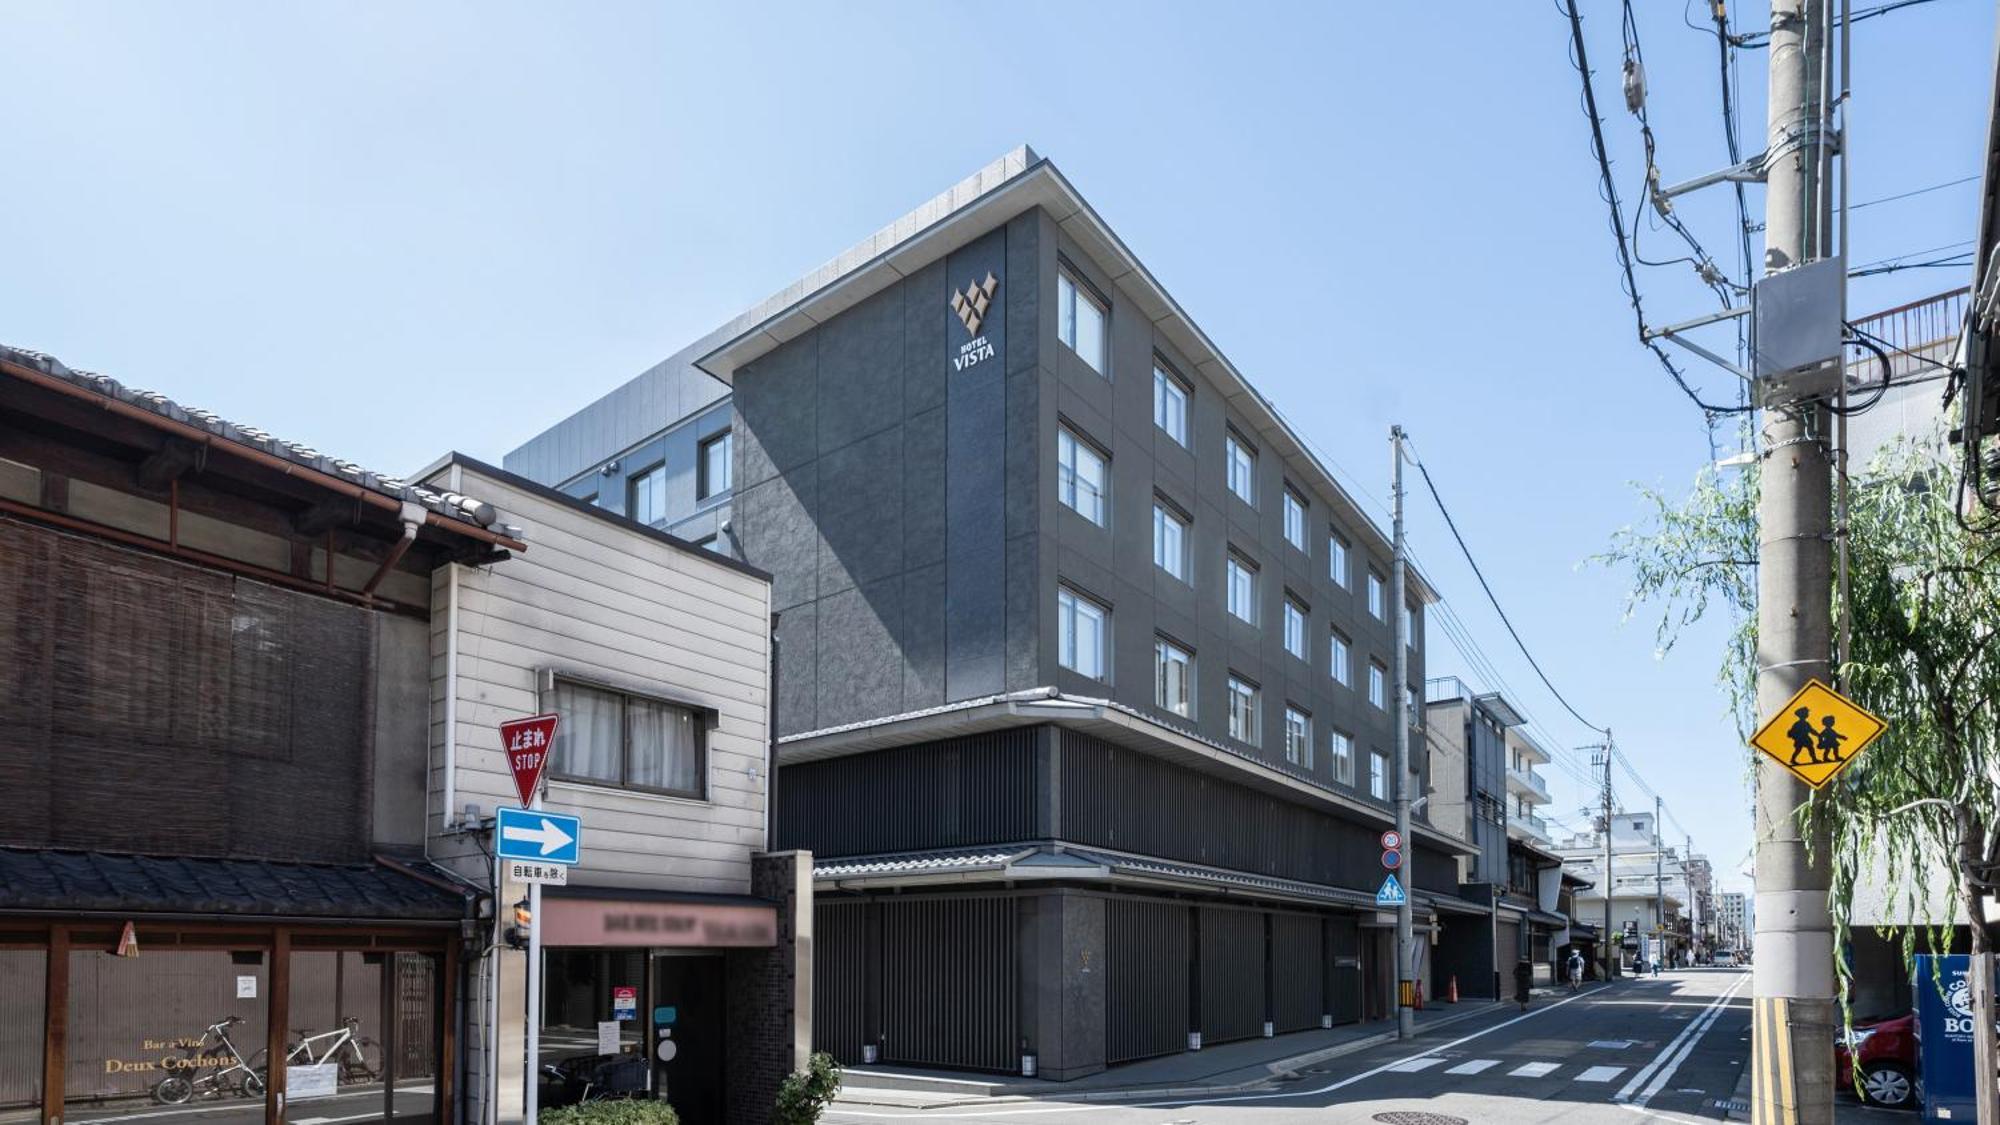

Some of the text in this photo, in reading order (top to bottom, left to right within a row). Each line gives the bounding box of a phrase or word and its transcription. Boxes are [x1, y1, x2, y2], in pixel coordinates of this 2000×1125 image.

[960, 336, 987, 354] HOTEL
[953, 343, 994, 371] VISTA
[510, 728, 545, 751] 止まれ
[515, 753, 541, 770] STOP
[513, 865, 565, 880] 自転車を除く
[143, 1040, 166, 1050] Bar
[105, 1054, 238, 1073] Deux Cochons
